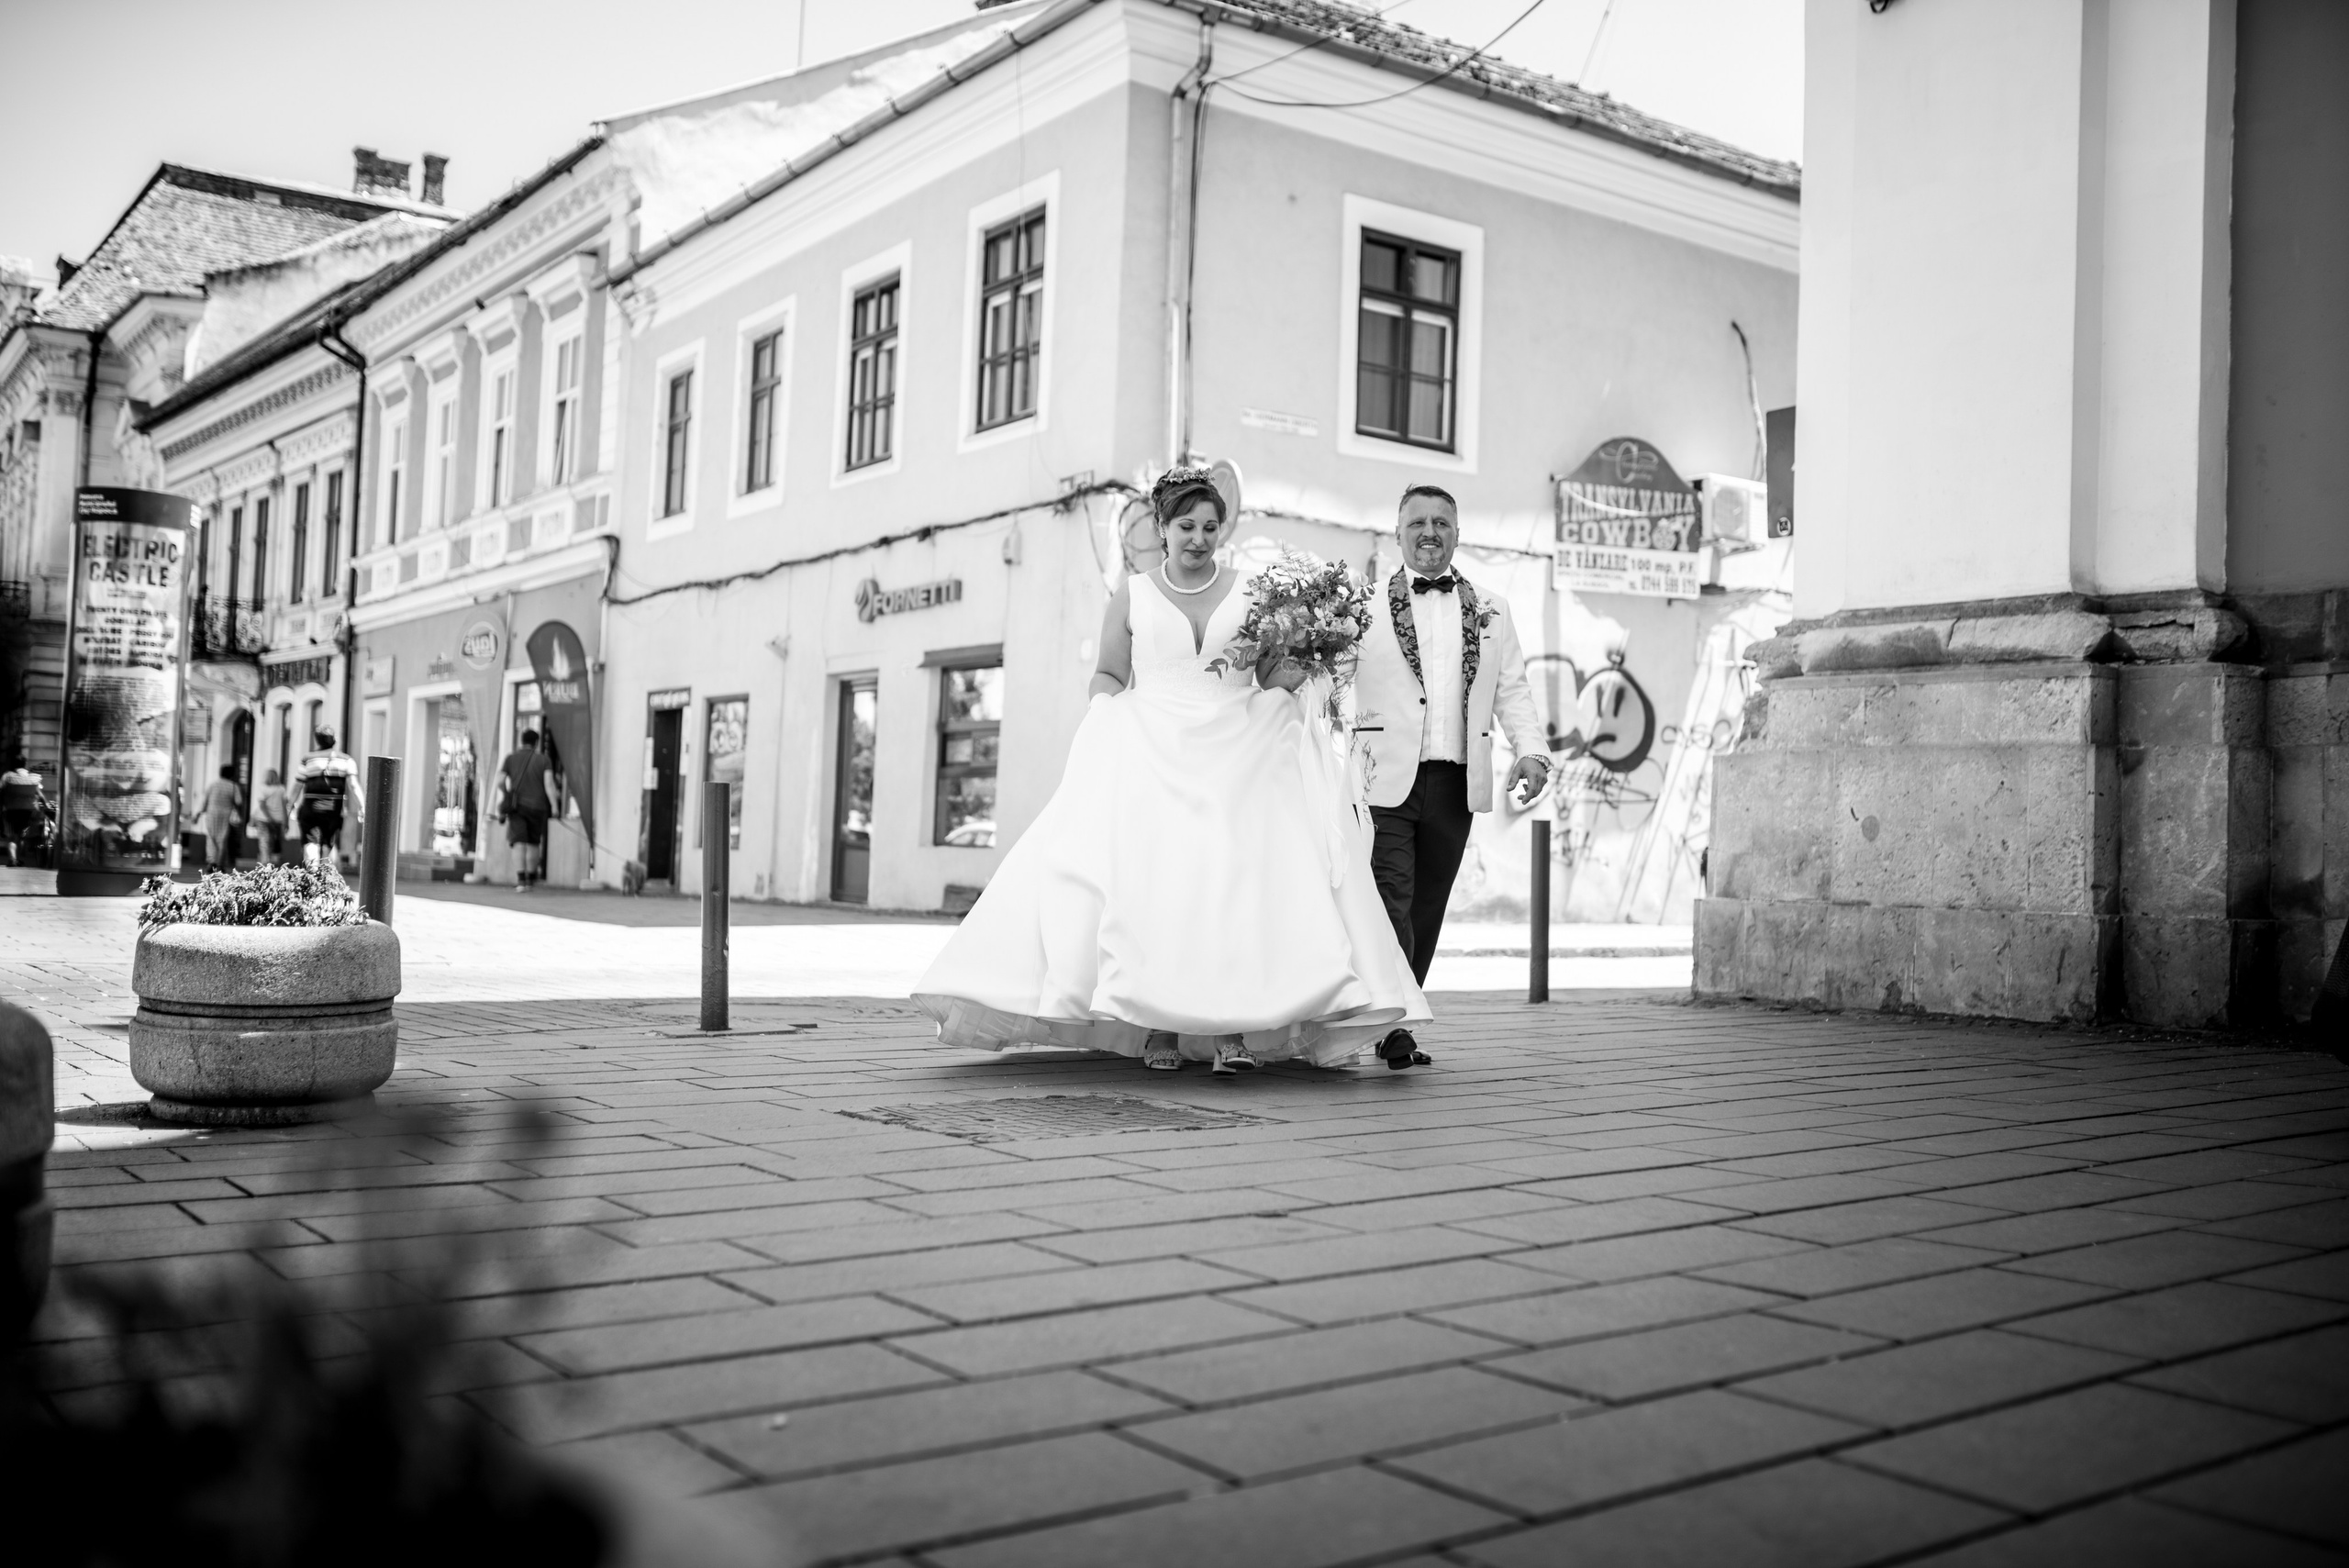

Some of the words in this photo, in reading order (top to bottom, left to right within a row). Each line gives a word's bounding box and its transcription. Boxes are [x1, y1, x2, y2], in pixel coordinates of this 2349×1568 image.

[1559, 481, 1697, 522] TRANSYLVANIA
[90, 561, 168, 587] CASTLE
[873, 580, 962, 617] FORNETTI
